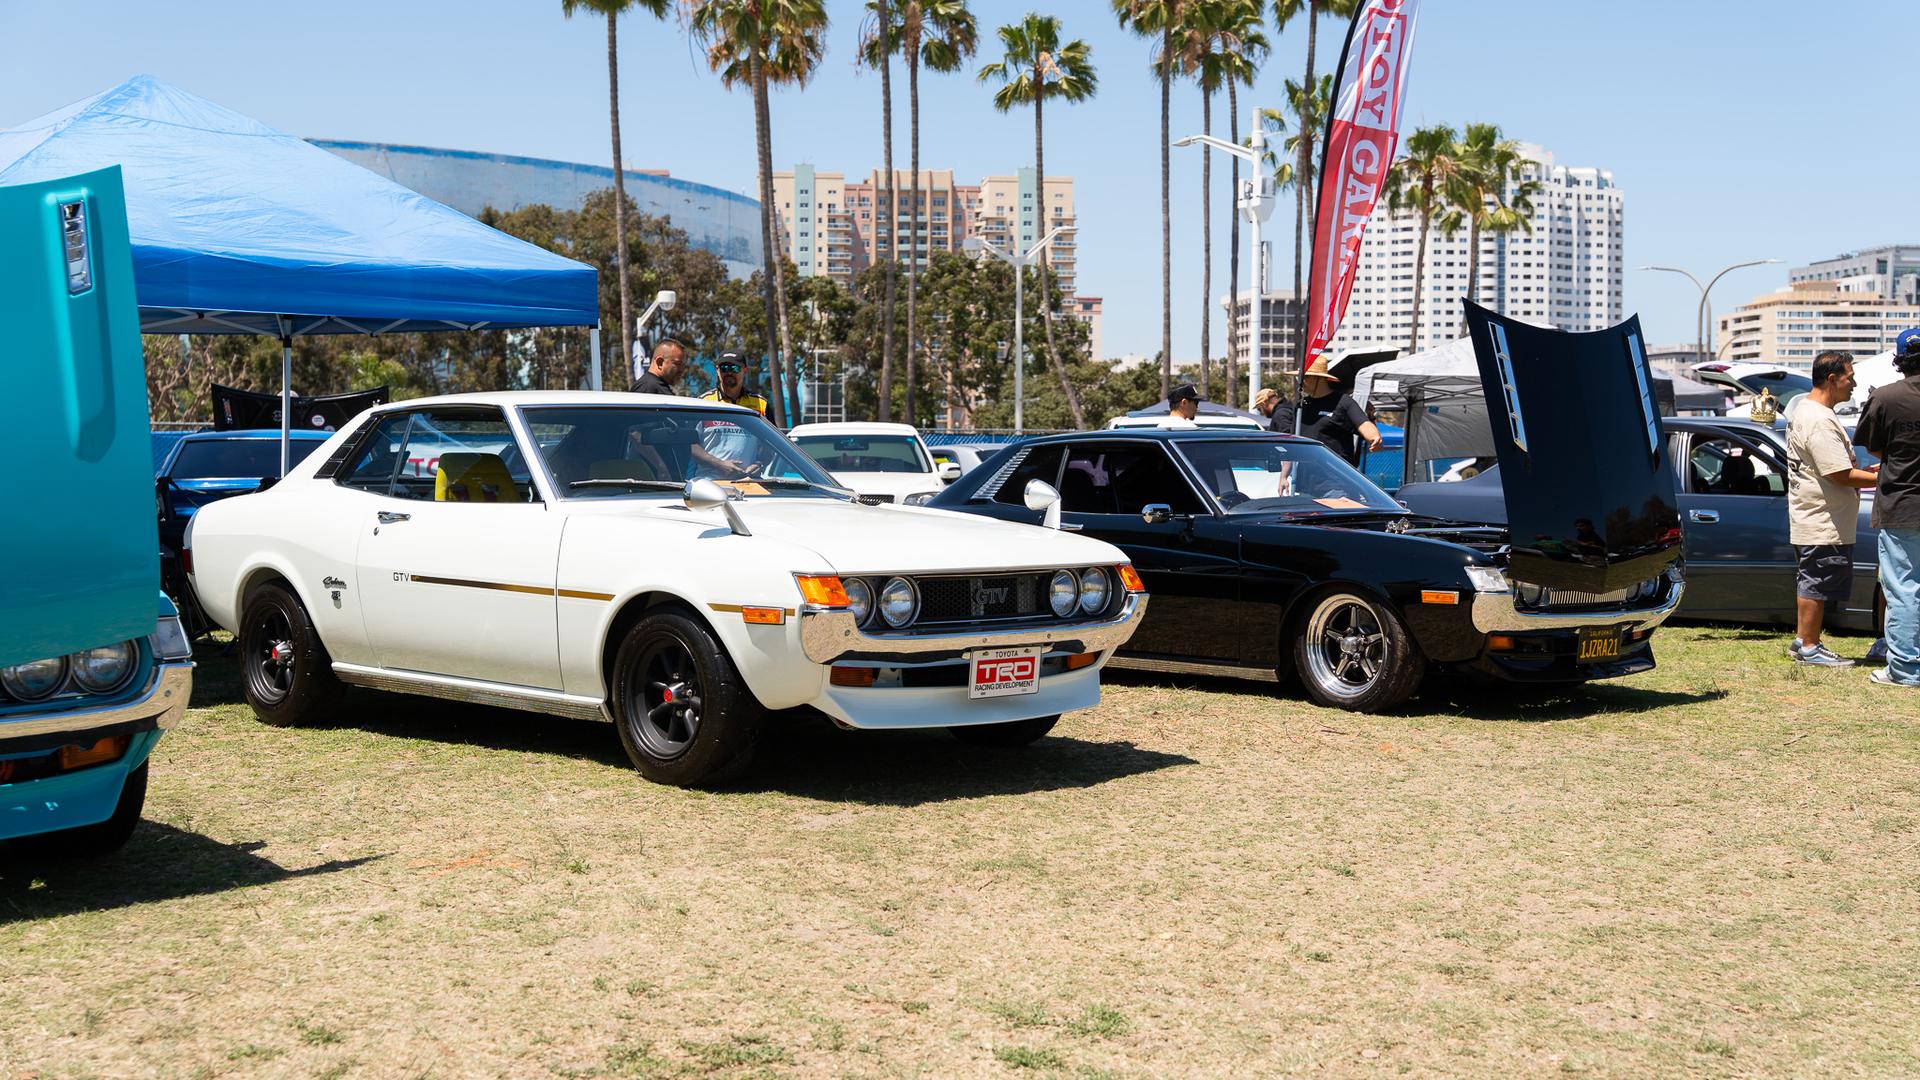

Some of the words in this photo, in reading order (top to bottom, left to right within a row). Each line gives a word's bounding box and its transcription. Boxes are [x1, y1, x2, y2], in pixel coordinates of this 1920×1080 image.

[393, 572, 410, 581] GTV
[976, 588, 1009, 605] GTV
[995, 650, 1019, 658] TOYOTA
[1580, 638, 1618, 658] 1JZRA21
[979, 661, 1032, 682] TRD
[974, 682, 995, 691] RACING
[995, 680, 1034, 690] DEVELOPMENT
